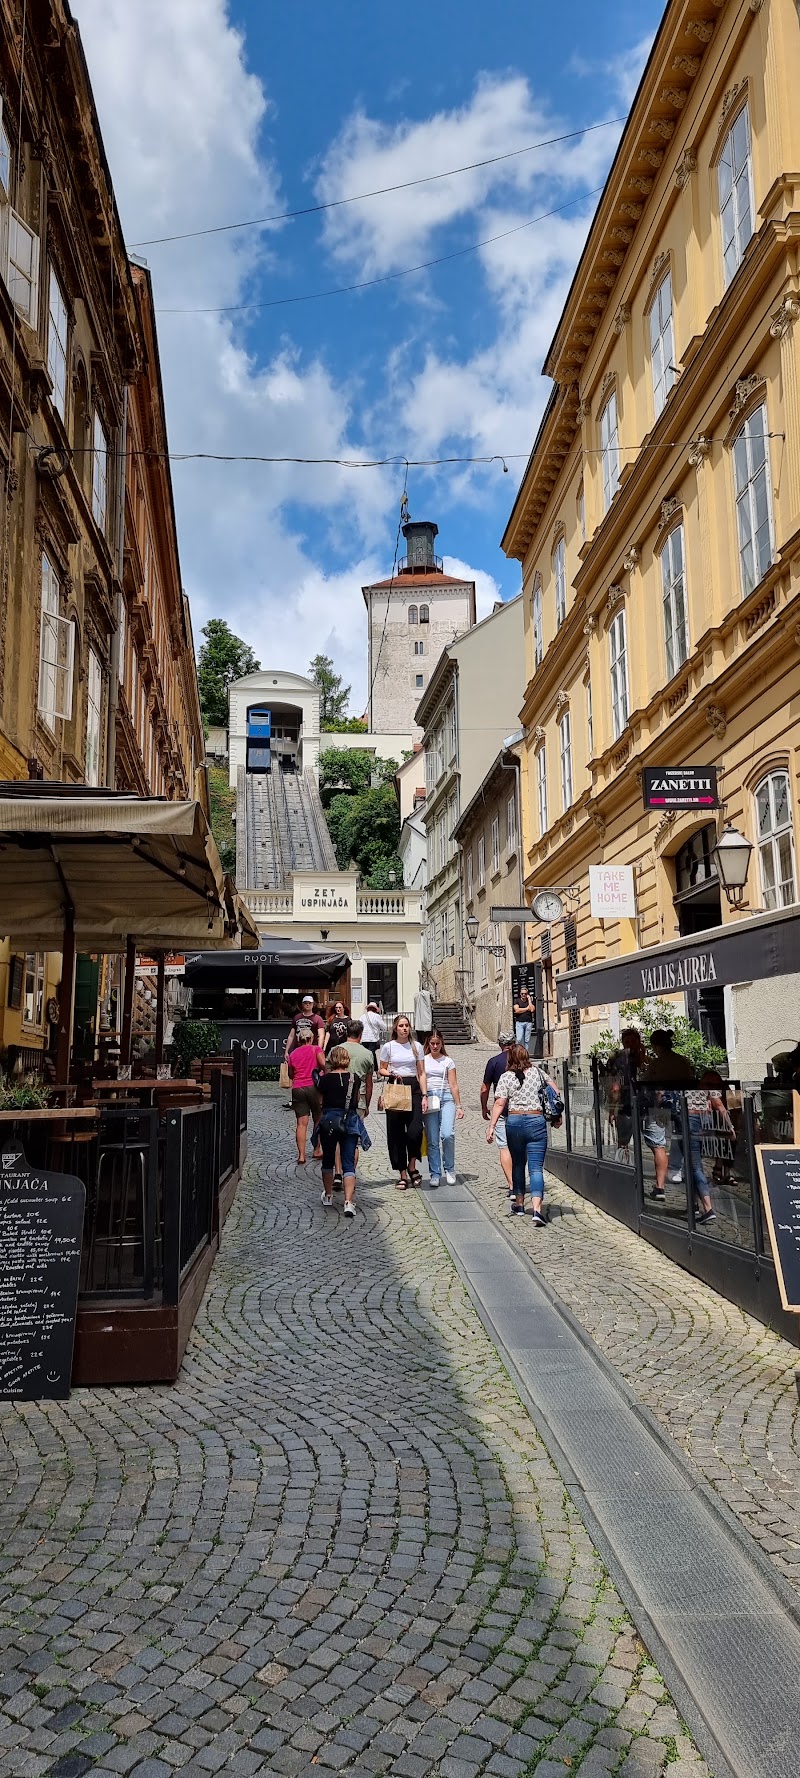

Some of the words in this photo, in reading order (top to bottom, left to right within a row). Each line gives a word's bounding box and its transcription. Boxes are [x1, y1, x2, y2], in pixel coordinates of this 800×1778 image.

[651, 779, 712, 790] ZANETTI
[598, 872, 624, 880] TAKE
[314, 888, 336, 896] ZET
[604, 882, 620, 892] ME
[302, 897, 348, 907] USPINJAČA
[598, 894, 628, 902] HOME
[244, 954, 280, 964] ROOTS
[640, 964, 676, 992] VALLIS
[676, 952, 717, 987] AUREA
[701, 1136, 734, 1160] AUREA
